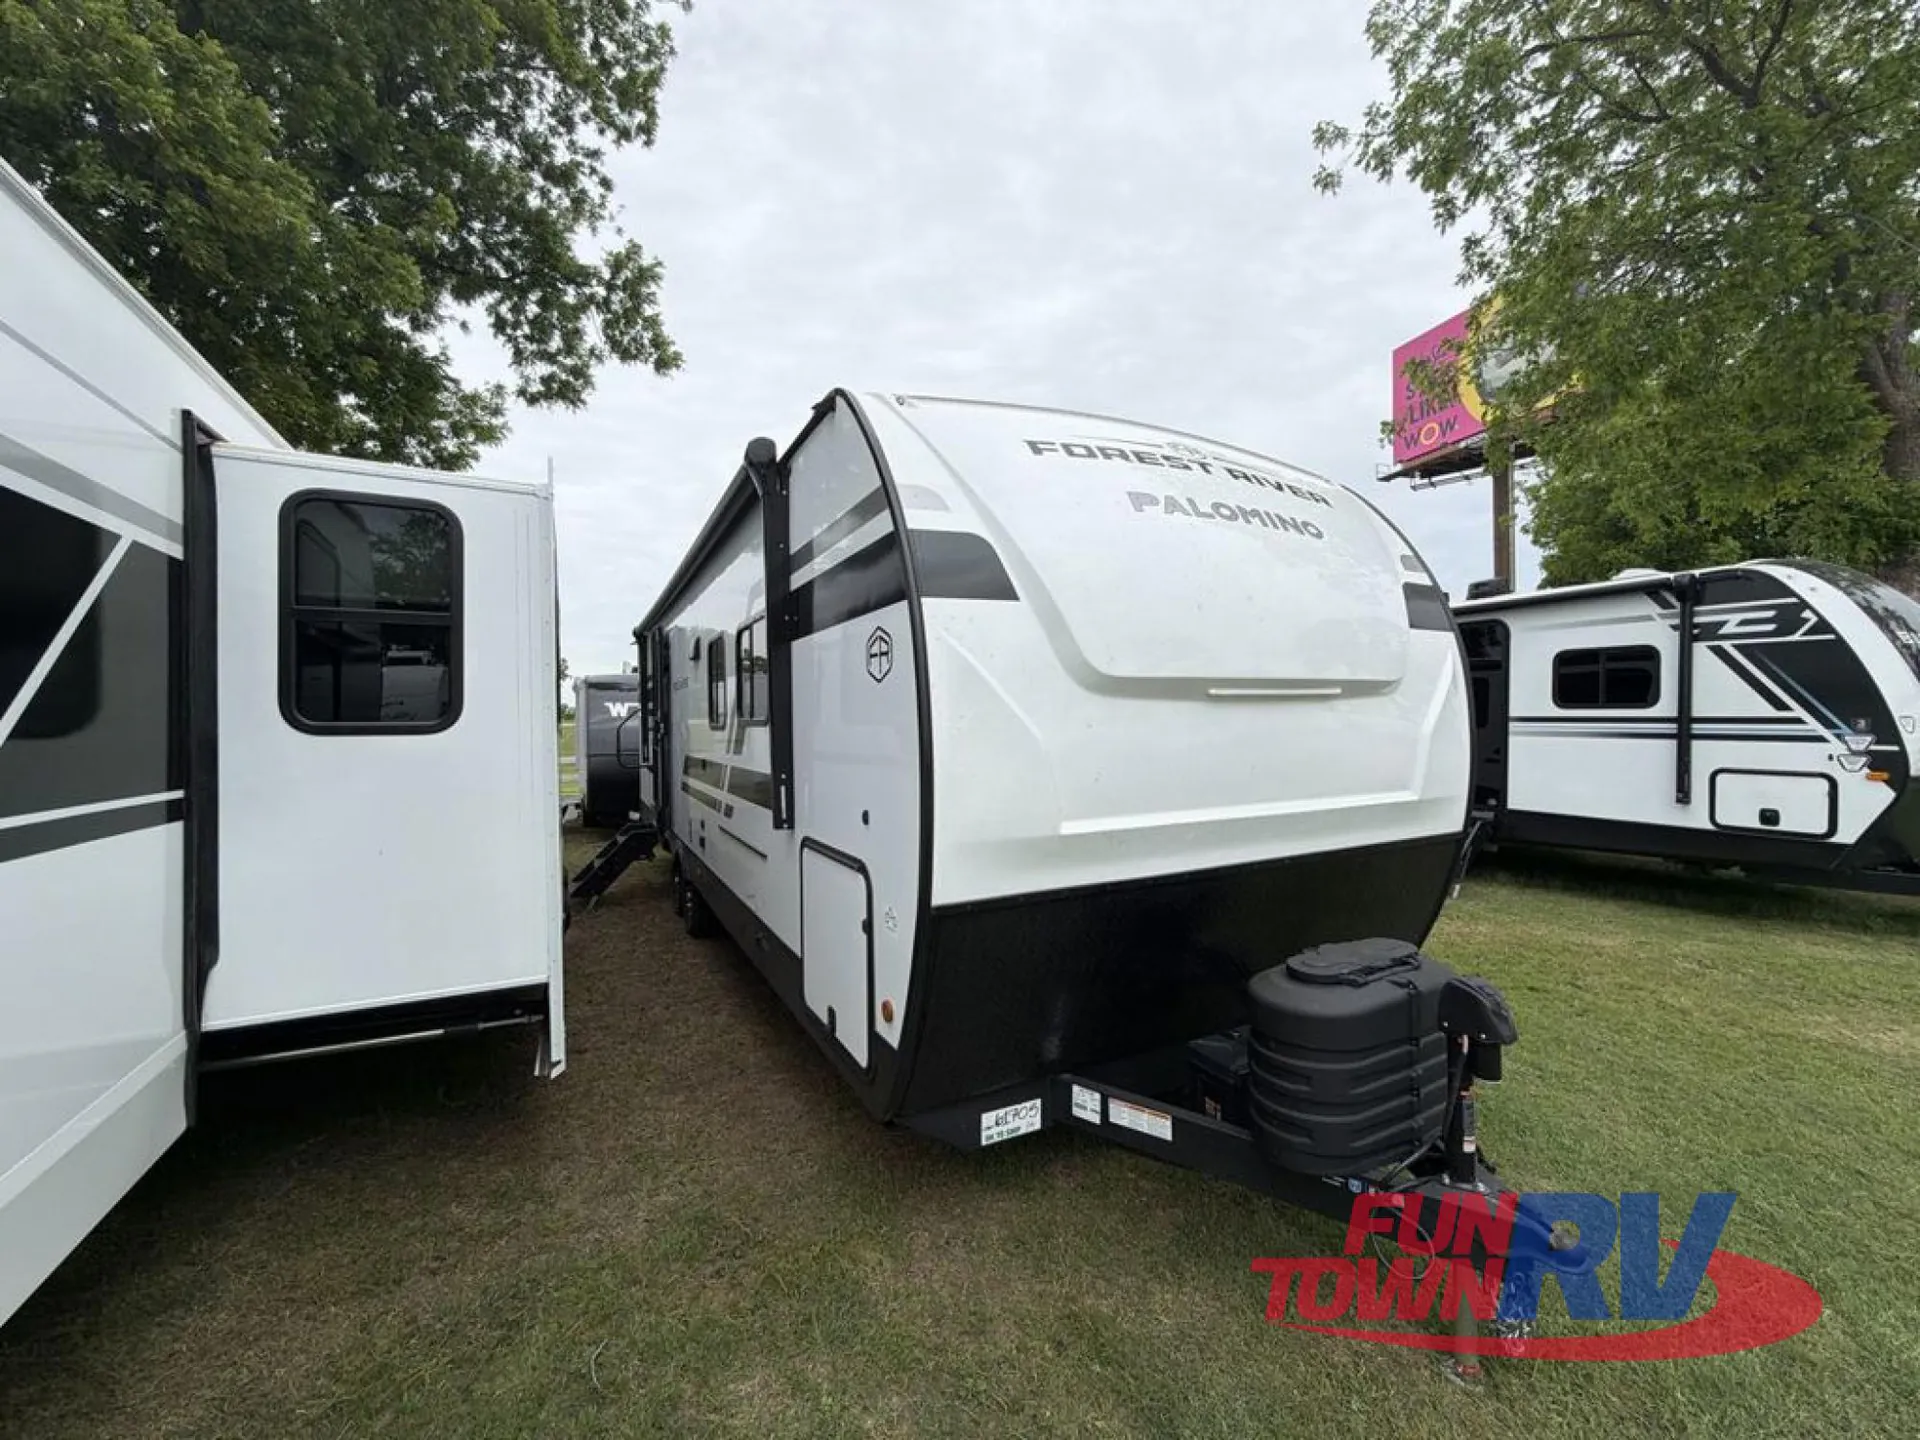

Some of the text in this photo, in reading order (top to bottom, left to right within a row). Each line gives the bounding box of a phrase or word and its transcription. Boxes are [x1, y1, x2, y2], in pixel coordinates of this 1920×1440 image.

[1024, 440, 1214, 475] FOREST
[1227, 466, 1333, 508] RIVER
[1127, 490, 1325, 540] PALOMINO
